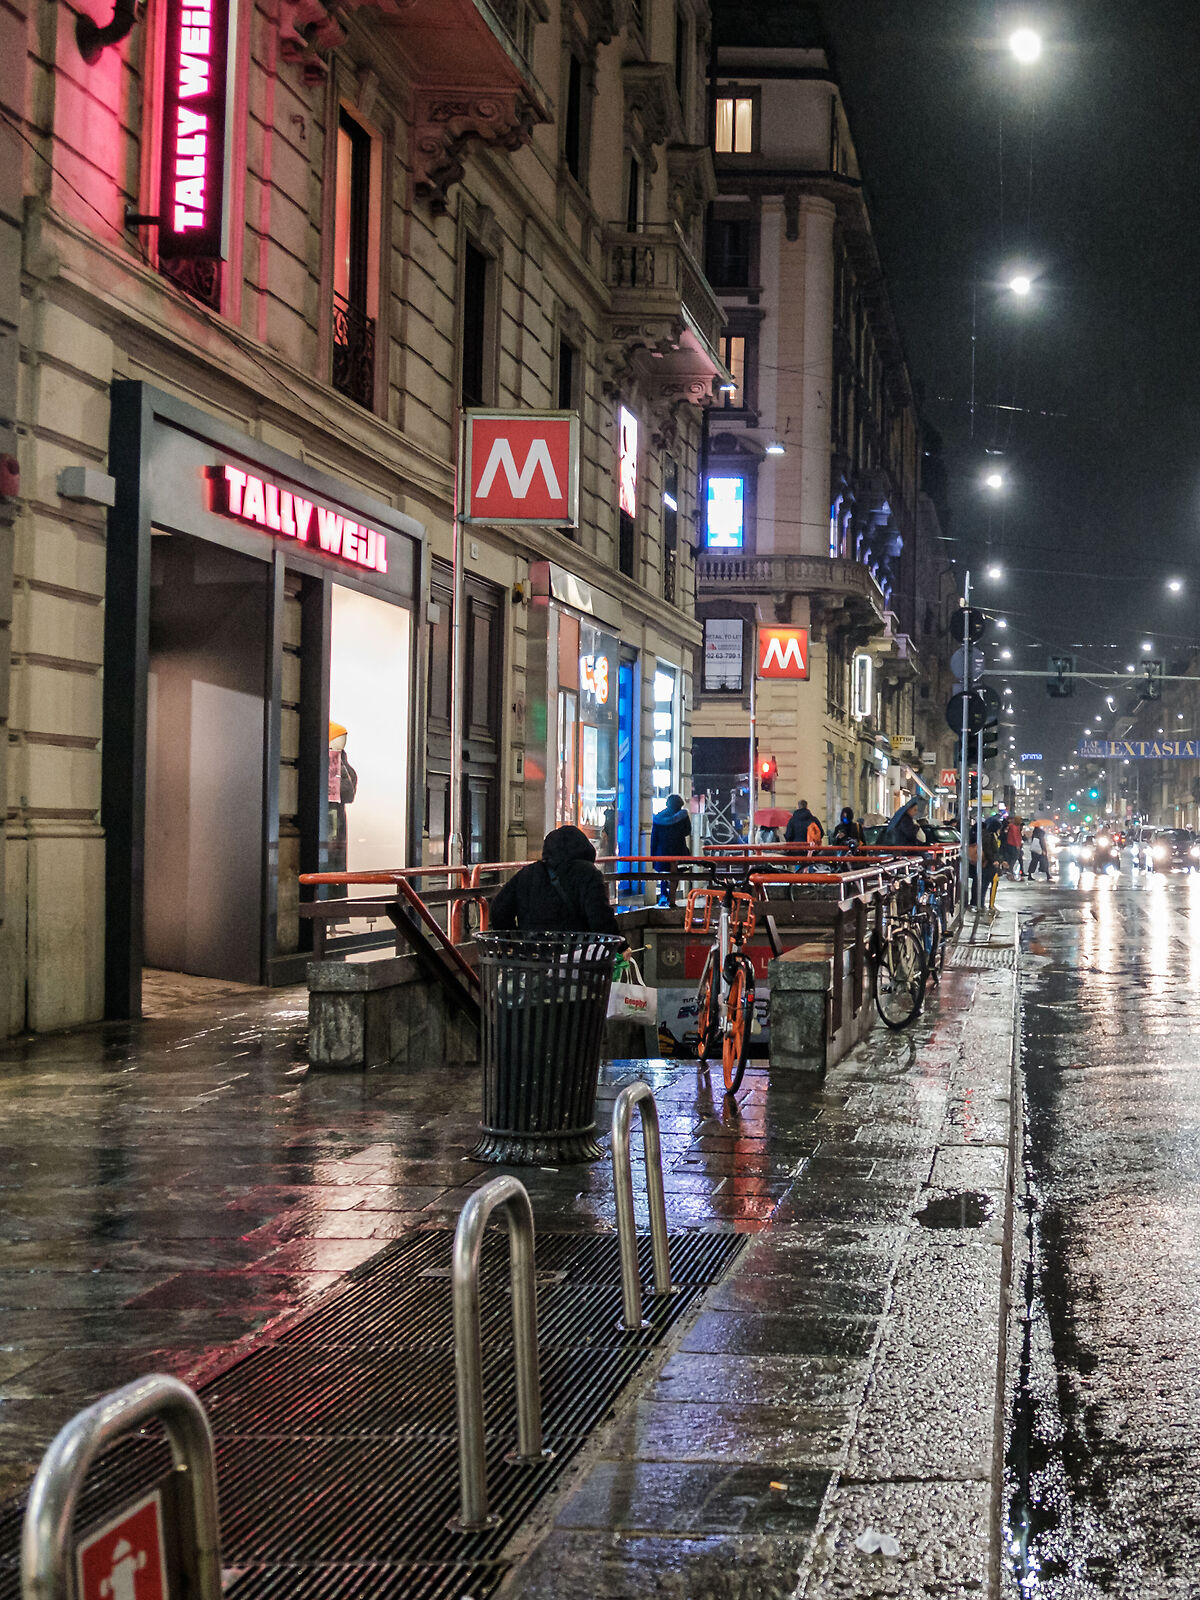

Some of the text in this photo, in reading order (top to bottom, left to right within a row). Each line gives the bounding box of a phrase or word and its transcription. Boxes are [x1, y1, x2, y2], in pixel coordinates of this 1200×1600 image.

[173, 105, 208, 233] TALLY
[224, 464, 314, 542] TALLY
[475, 439, 563, 499] M
[762, 638, 805, 670] M
